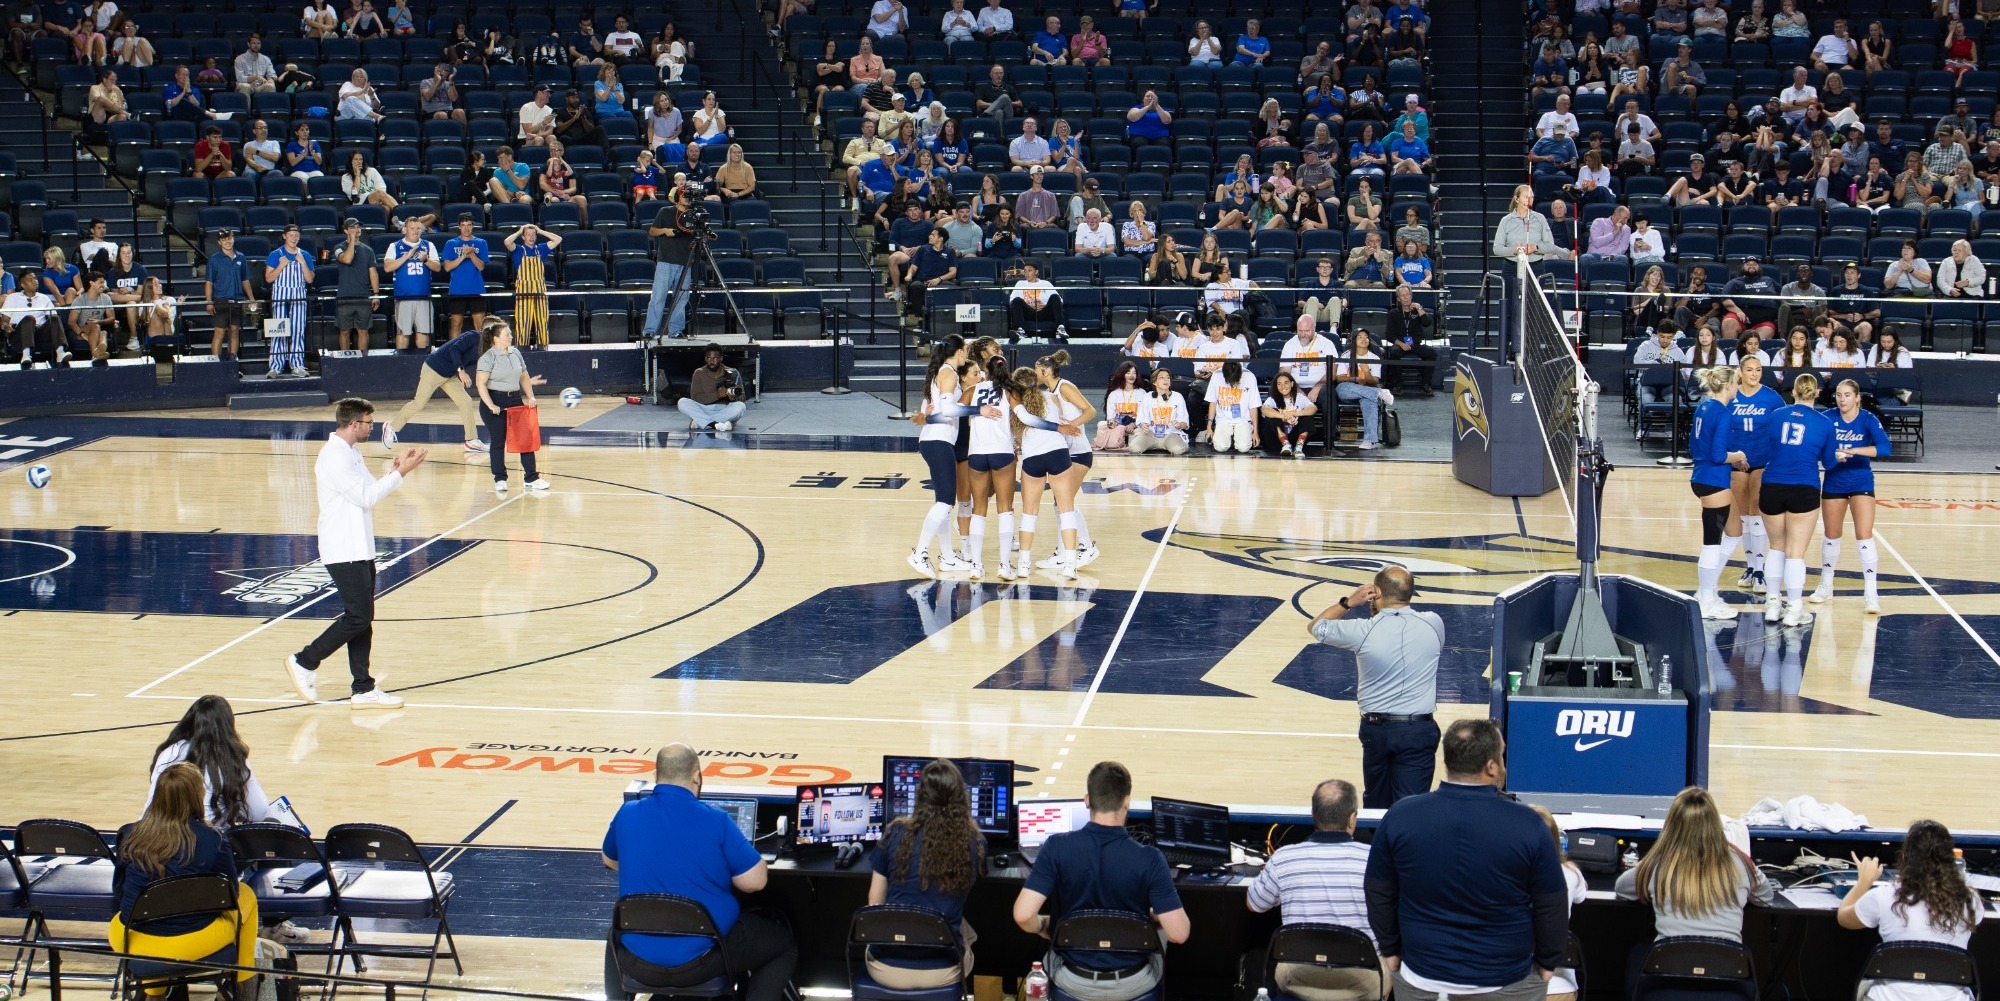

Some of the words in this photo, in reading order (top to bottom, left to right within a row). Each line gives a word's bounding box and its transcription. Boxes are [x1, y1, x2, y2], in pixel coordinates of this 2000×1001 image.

[1986, 127, 2000, 138] OR
[407, 262, 424, 276] 25
[977, 389, 1000, 407] 22
[1732, 403, 1766, 416] Tulsa
[1743, 417, 1754, 432] 11
[1780, 422, 1806, 446] 13
[1835, 428, 1864, 441] Tulsa
[1555, 709, 1636, 738] ORU
[465, 742, 638, 755] MORTGAGE
[697, 749, 800, 760] BANKI
[376, 746, 853, 787] Gaeway
[834, 811, 854, 819] FOLLOW
[855, 809, 864, 819] US
